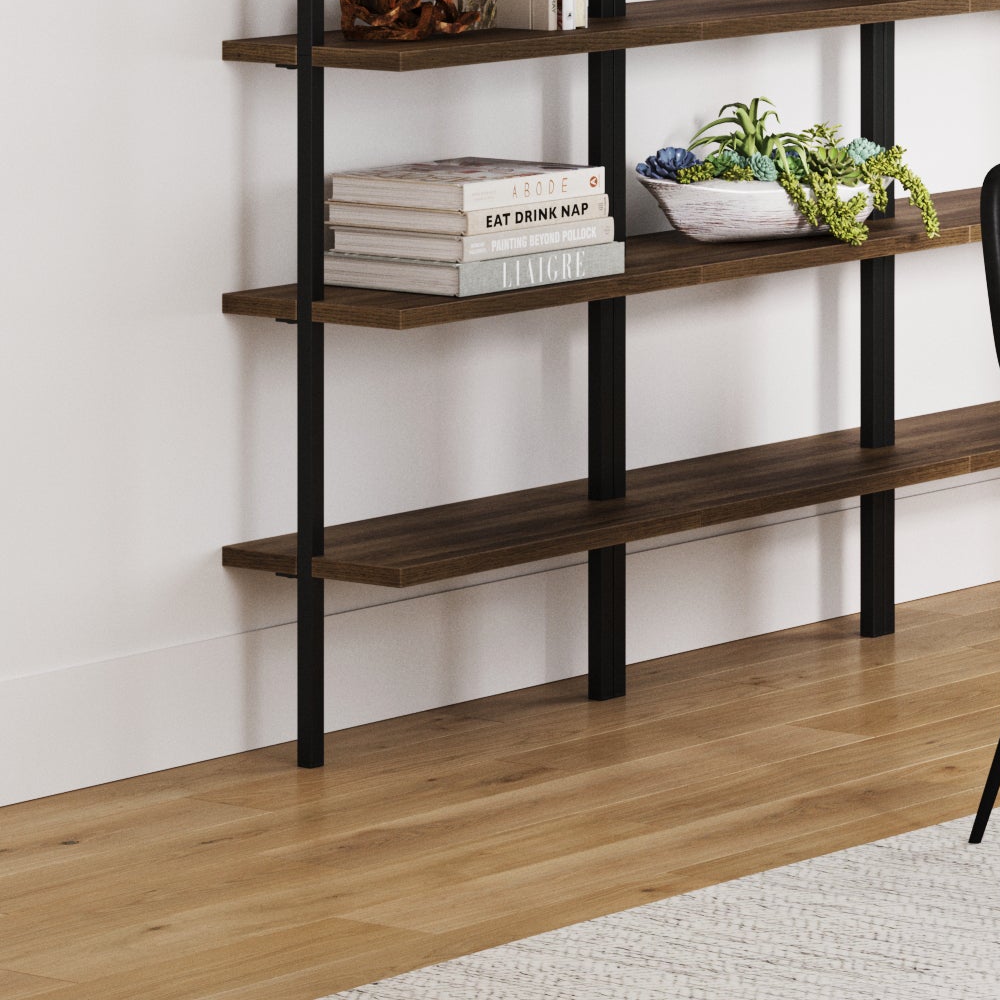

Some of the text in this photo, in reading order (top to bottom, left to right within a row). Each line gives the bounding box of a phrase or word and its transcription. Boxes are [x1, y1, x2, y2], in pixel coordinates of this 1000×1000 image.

[512, 177, 569, 198] ABODE
[486, 213, 511, 228] EAT
[515, 206, 557, 224] DRINK
[561, 202, 589, 218] NAP
[491, 234, 527, 251] PAINTING
[529, 231, 560, 247] BEYOND
[562, 226, 597, 243] POLLOCK
[502, 250, 586, 289] LIAIGRE
